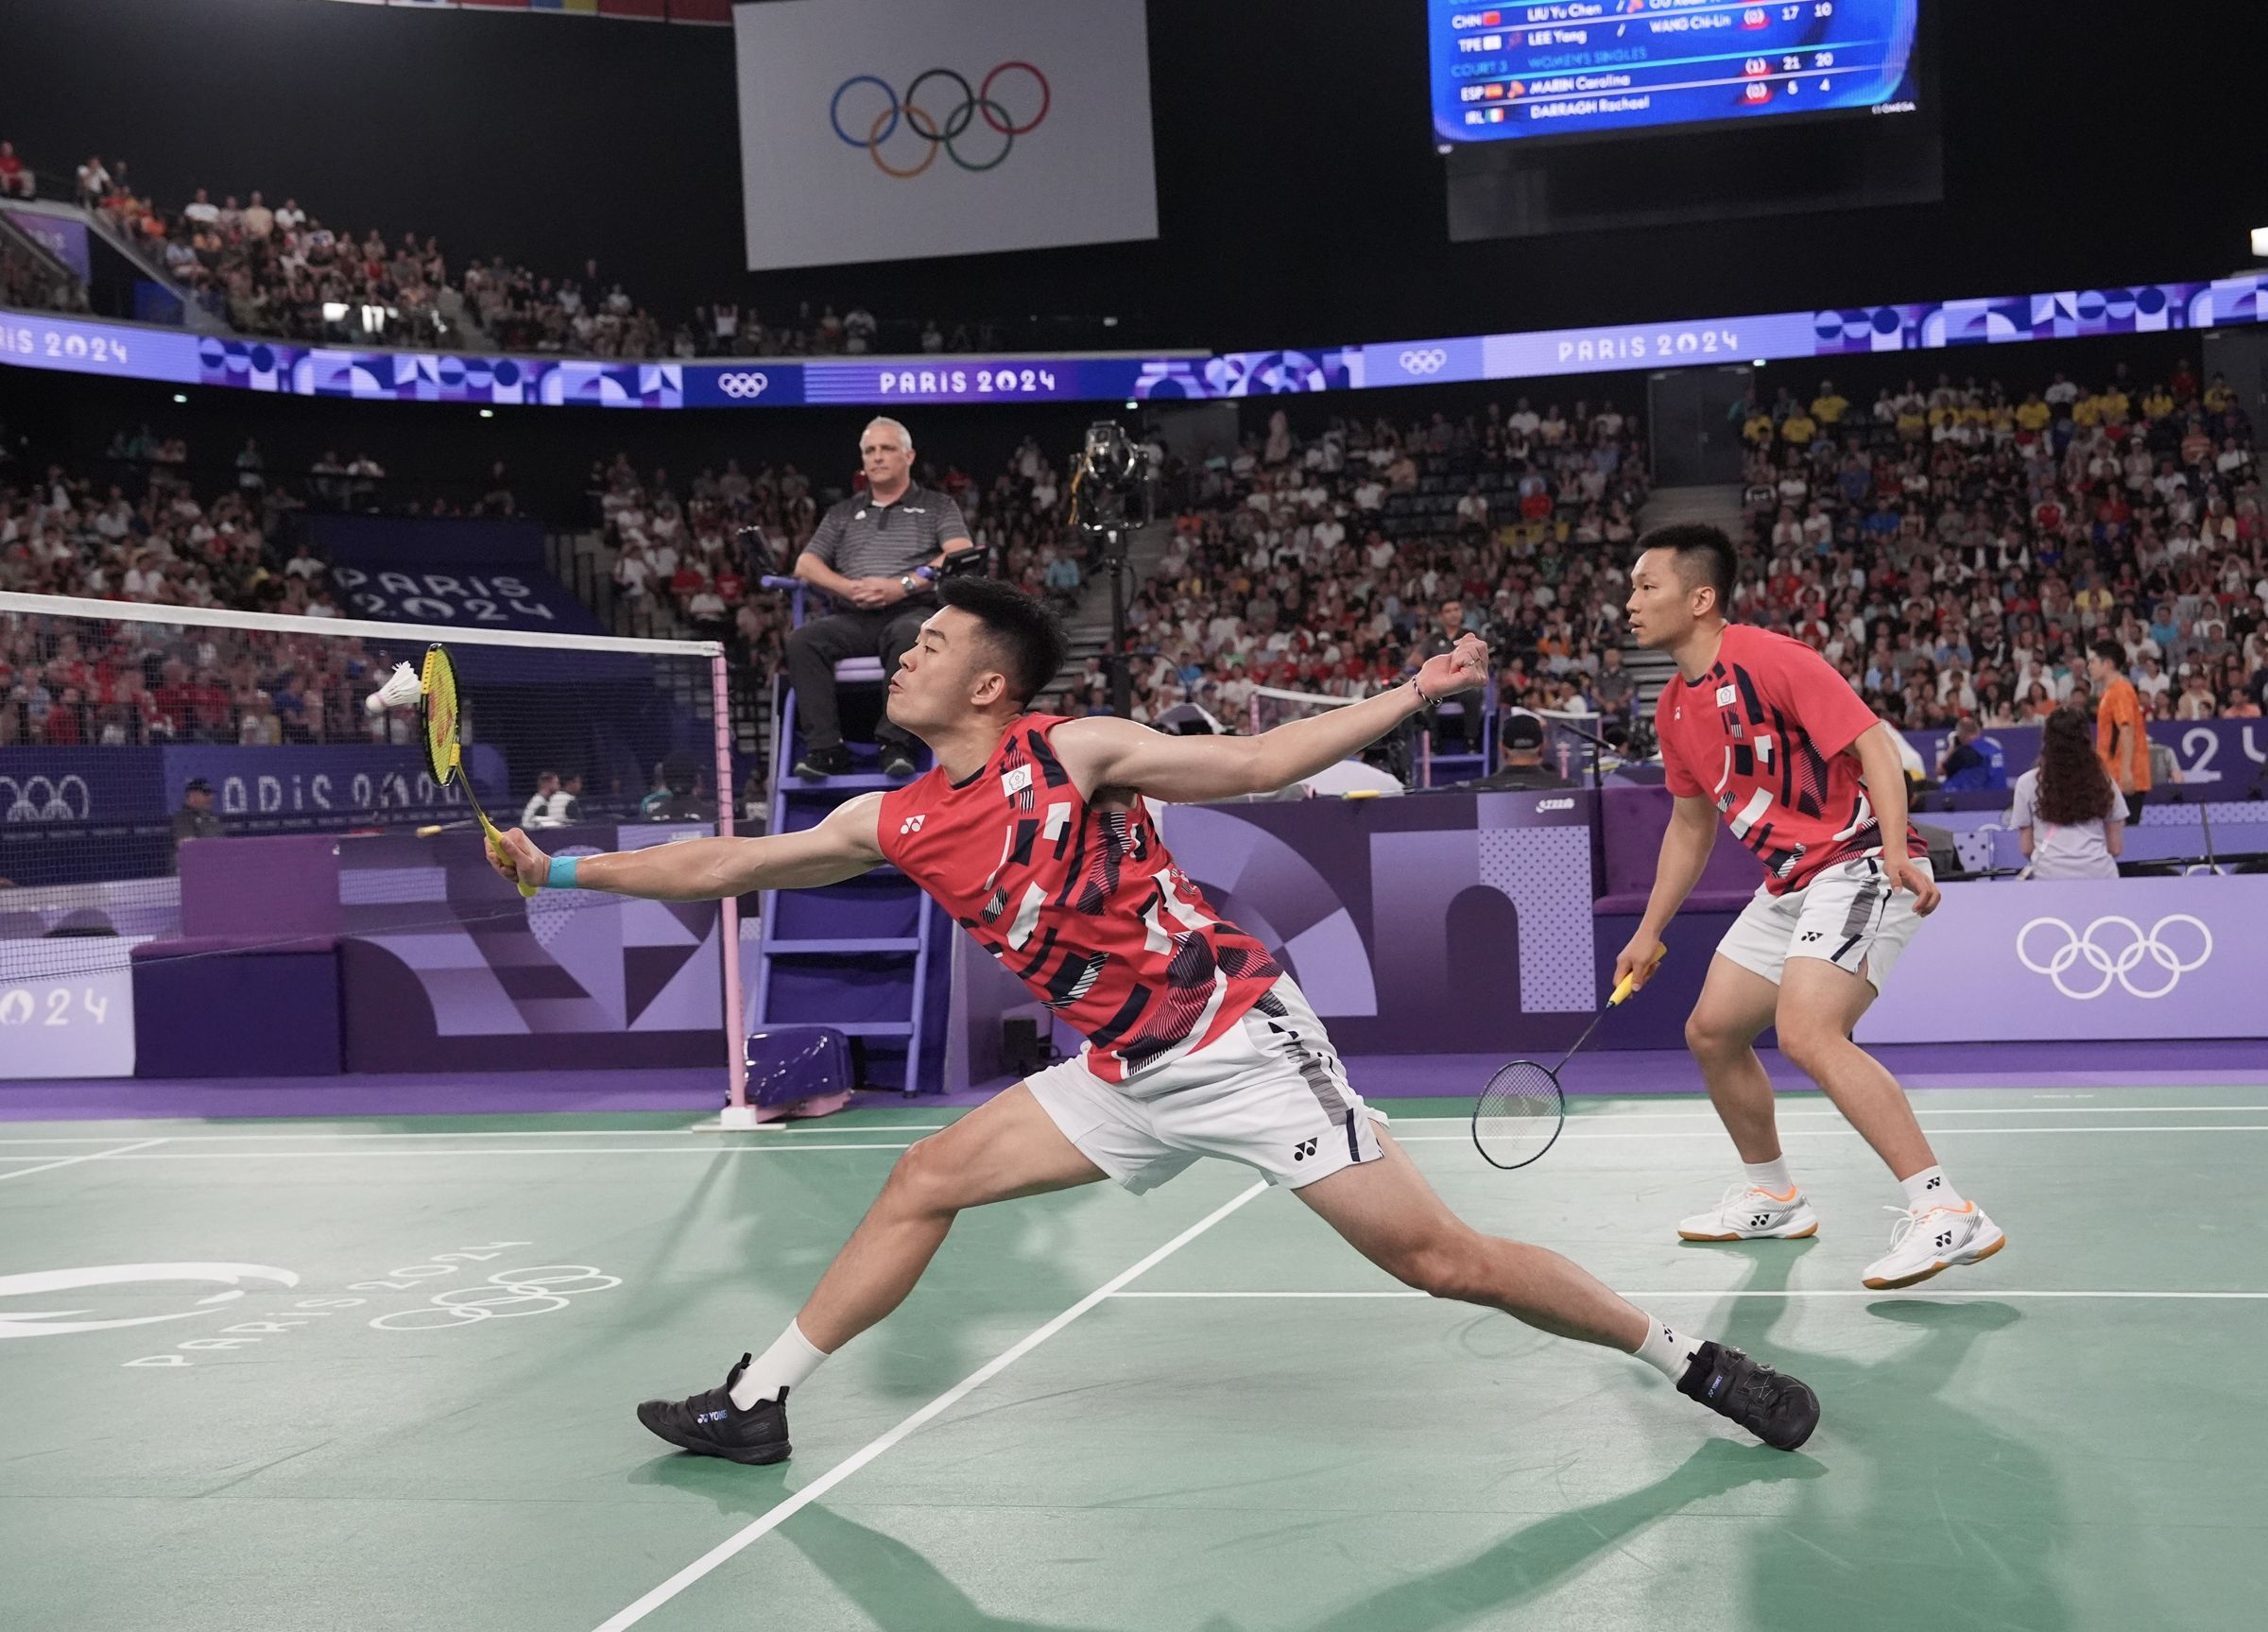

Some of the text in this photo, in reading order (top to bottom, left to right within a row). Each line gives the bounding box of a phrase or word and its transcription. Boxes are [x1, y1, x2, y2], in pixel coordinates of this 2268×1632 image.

[1452, 14, 1482, 29] CHN
[1527, 7, 1549, 22] LIU
[1550, 6, 1567, 19] Yu
[1568, 2, 1602, 18] Chen
[1458, 37, 1482, 52] TPE
[1527, 30, 1553, 46] LEE
[1554, 29, 1587, 44] Yang
[1650, 17, 1689, 33] WANG
[1690, 14, 1731, 29] Chi-Lin
[1781, 5, 1800, 21] 17
[1814, 2, 1832, 17] 10
[1593, 46, 1647, 63] SINGLES
[1451, 60, 1496, 77] COURT
[1460, 85, 1485, 101] ESP
[1529, 77, 1574, 94] MARIN
[1575, 74, 1630, 91] Carolina
[1782, 55, 1801, 71] 21
[1814, 51, 1833, 67] 20
[1530, 99, 1597, 119] DARRAGH
[44, 332, 128, 364] 2024
[1657, 331, 1738, 356] 2024
[977, 369, 1055, 393] 2024
[352, 596, 557, 621] 2024
[346, 1241, 533, 1291] 2024
